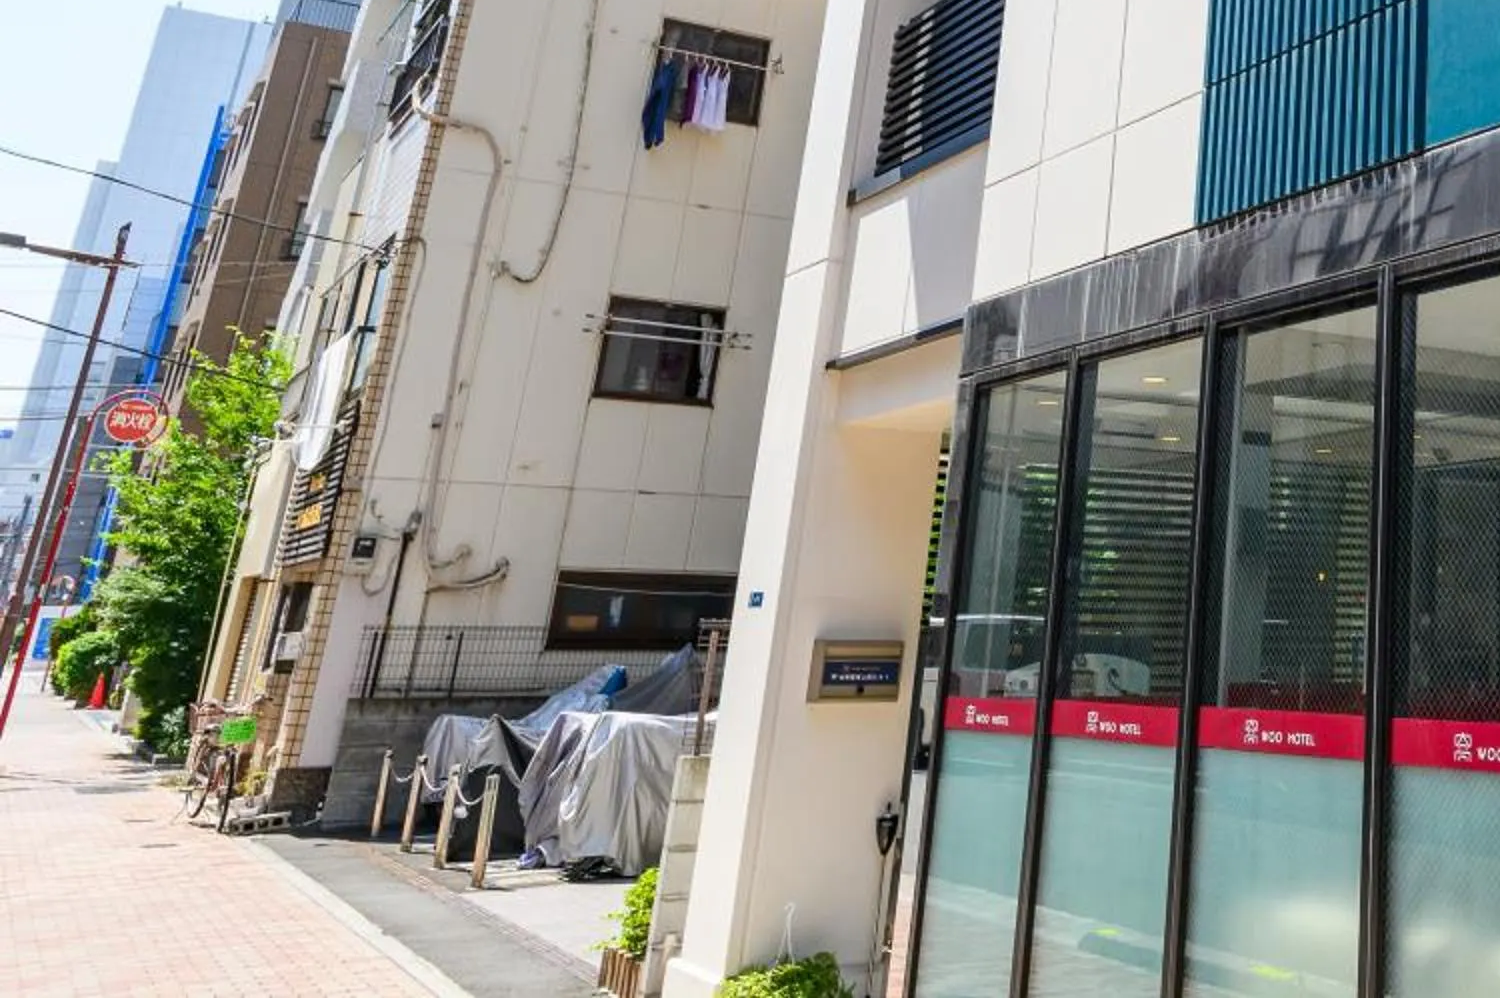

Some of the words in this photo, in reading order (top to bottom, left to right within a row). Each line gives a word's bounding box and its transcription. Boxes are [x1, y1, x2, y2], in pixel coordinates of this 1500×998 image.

[110, 410, 155, 431] 消火栓
[1100, 721, 1116, 733] WOO
[1261, 730, 1283, 744] WOO
[1287, 732, 1316, 747] HOTEL
